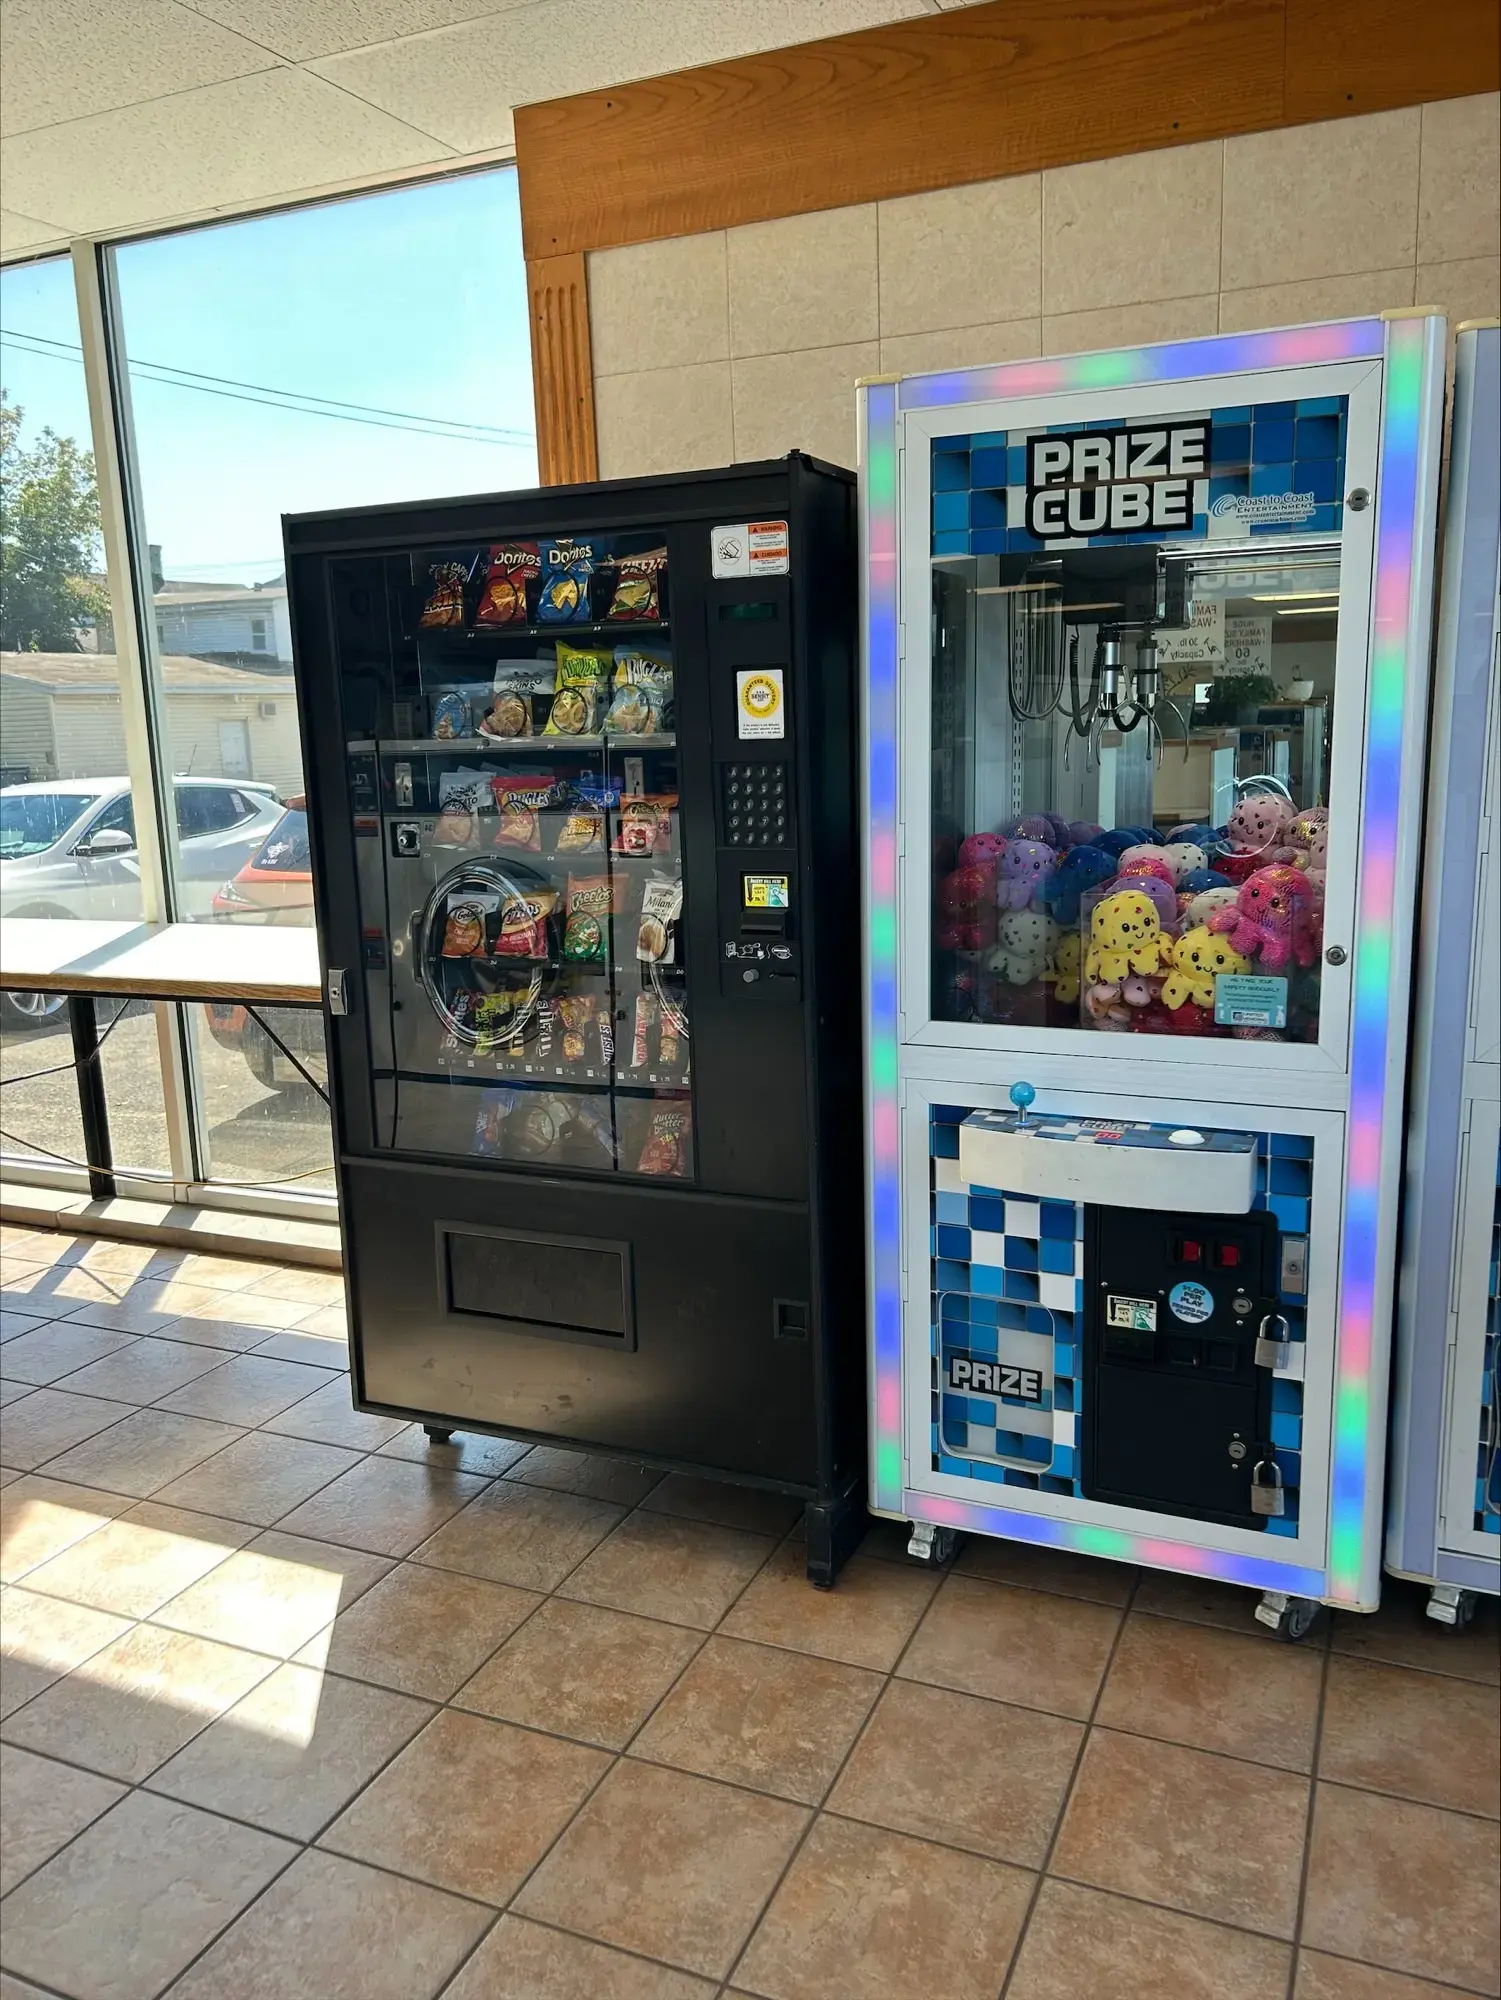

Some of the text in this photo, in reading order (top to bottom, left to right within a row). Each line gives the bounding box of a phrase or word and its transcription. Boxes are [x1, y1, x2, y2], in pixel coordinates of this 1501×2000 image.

[1033, 427, 1205, 487] PRIZE
[1032, 479, 1188, 534] CUBE
[1237, 492, 1314, 506] Coast to Coast
[1237, 503, 1313, 513] ENTERTAINMENT
[494, 552, 542, 567] Doritos
[549, 545, 593, 565] Doritos
[745, 679, 764, 706] GUARANTEED
[570, 885, 614, 912] Cheetos
[644, 895, 676, 909] Milano
[1180, 1296, 1204, 1307] PLAY
[1183, 1291, 1202, 1301] PER
[952, 1358, 1038, 1399] PRIZE
